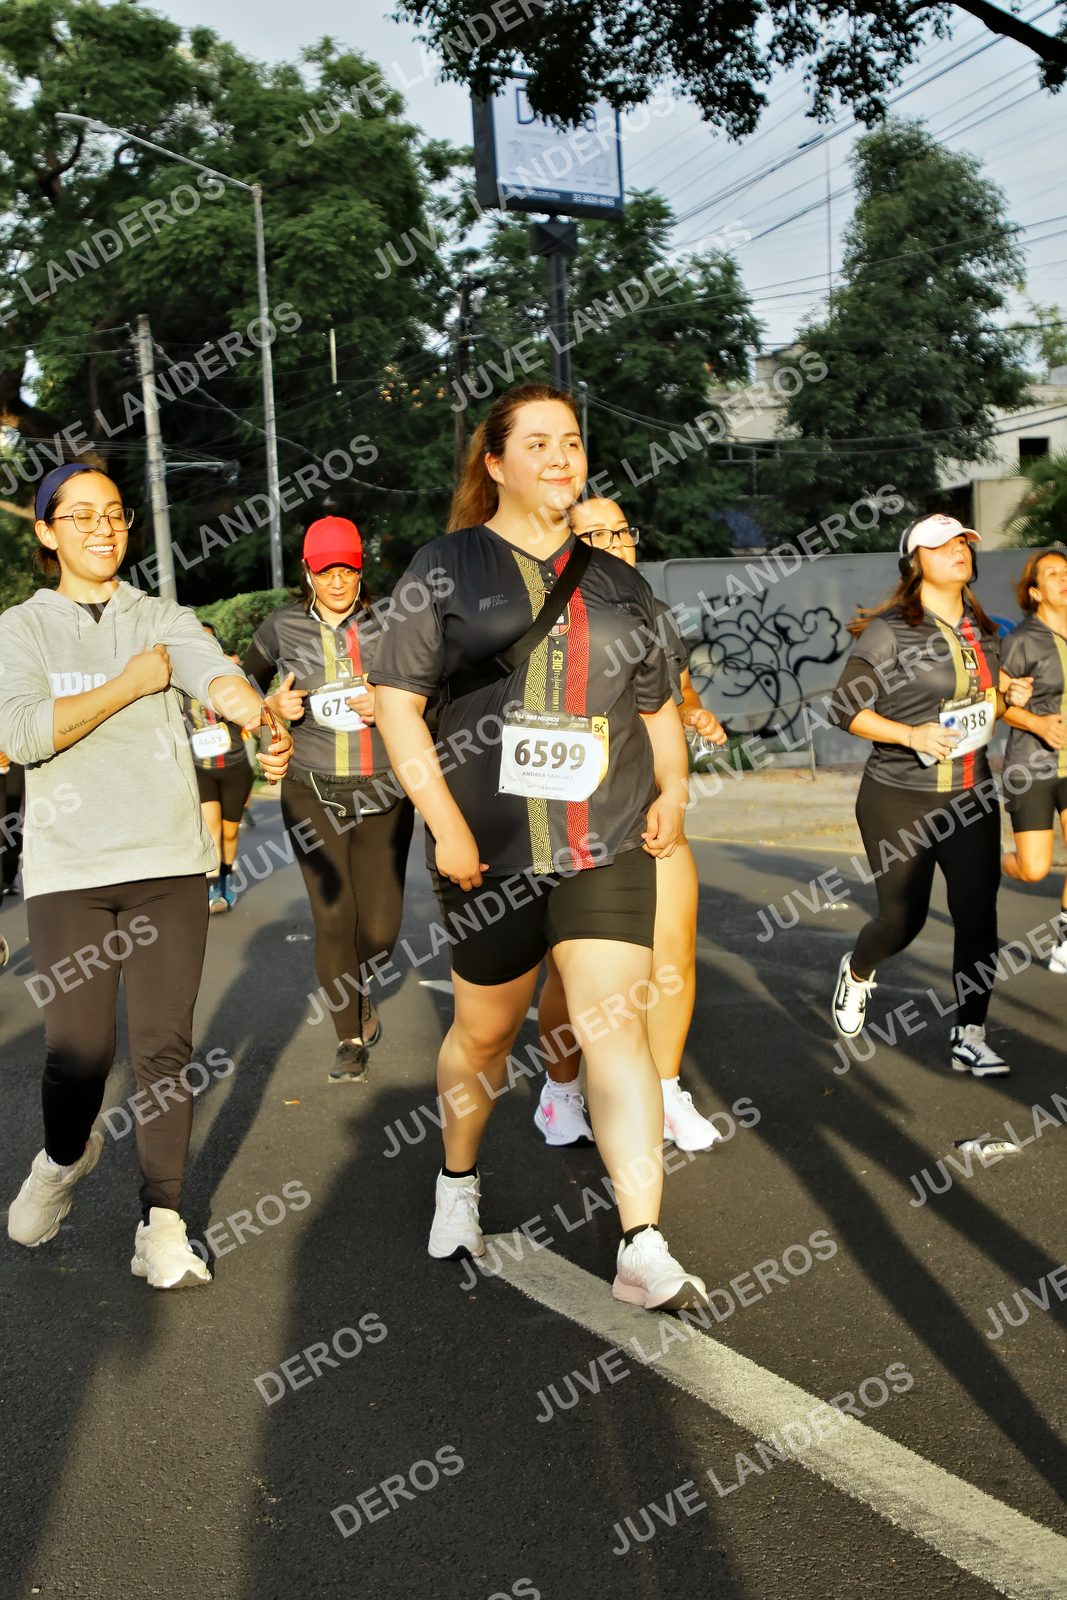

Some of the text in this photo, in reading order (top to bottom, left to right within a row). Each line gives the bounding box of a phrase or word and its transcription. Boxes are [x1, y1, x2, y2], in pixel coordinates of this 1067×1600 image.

[593, 723, 605, 734] 5K
[961, 710, 987, 731] 938
[514, 739, 586, 770] 6599
